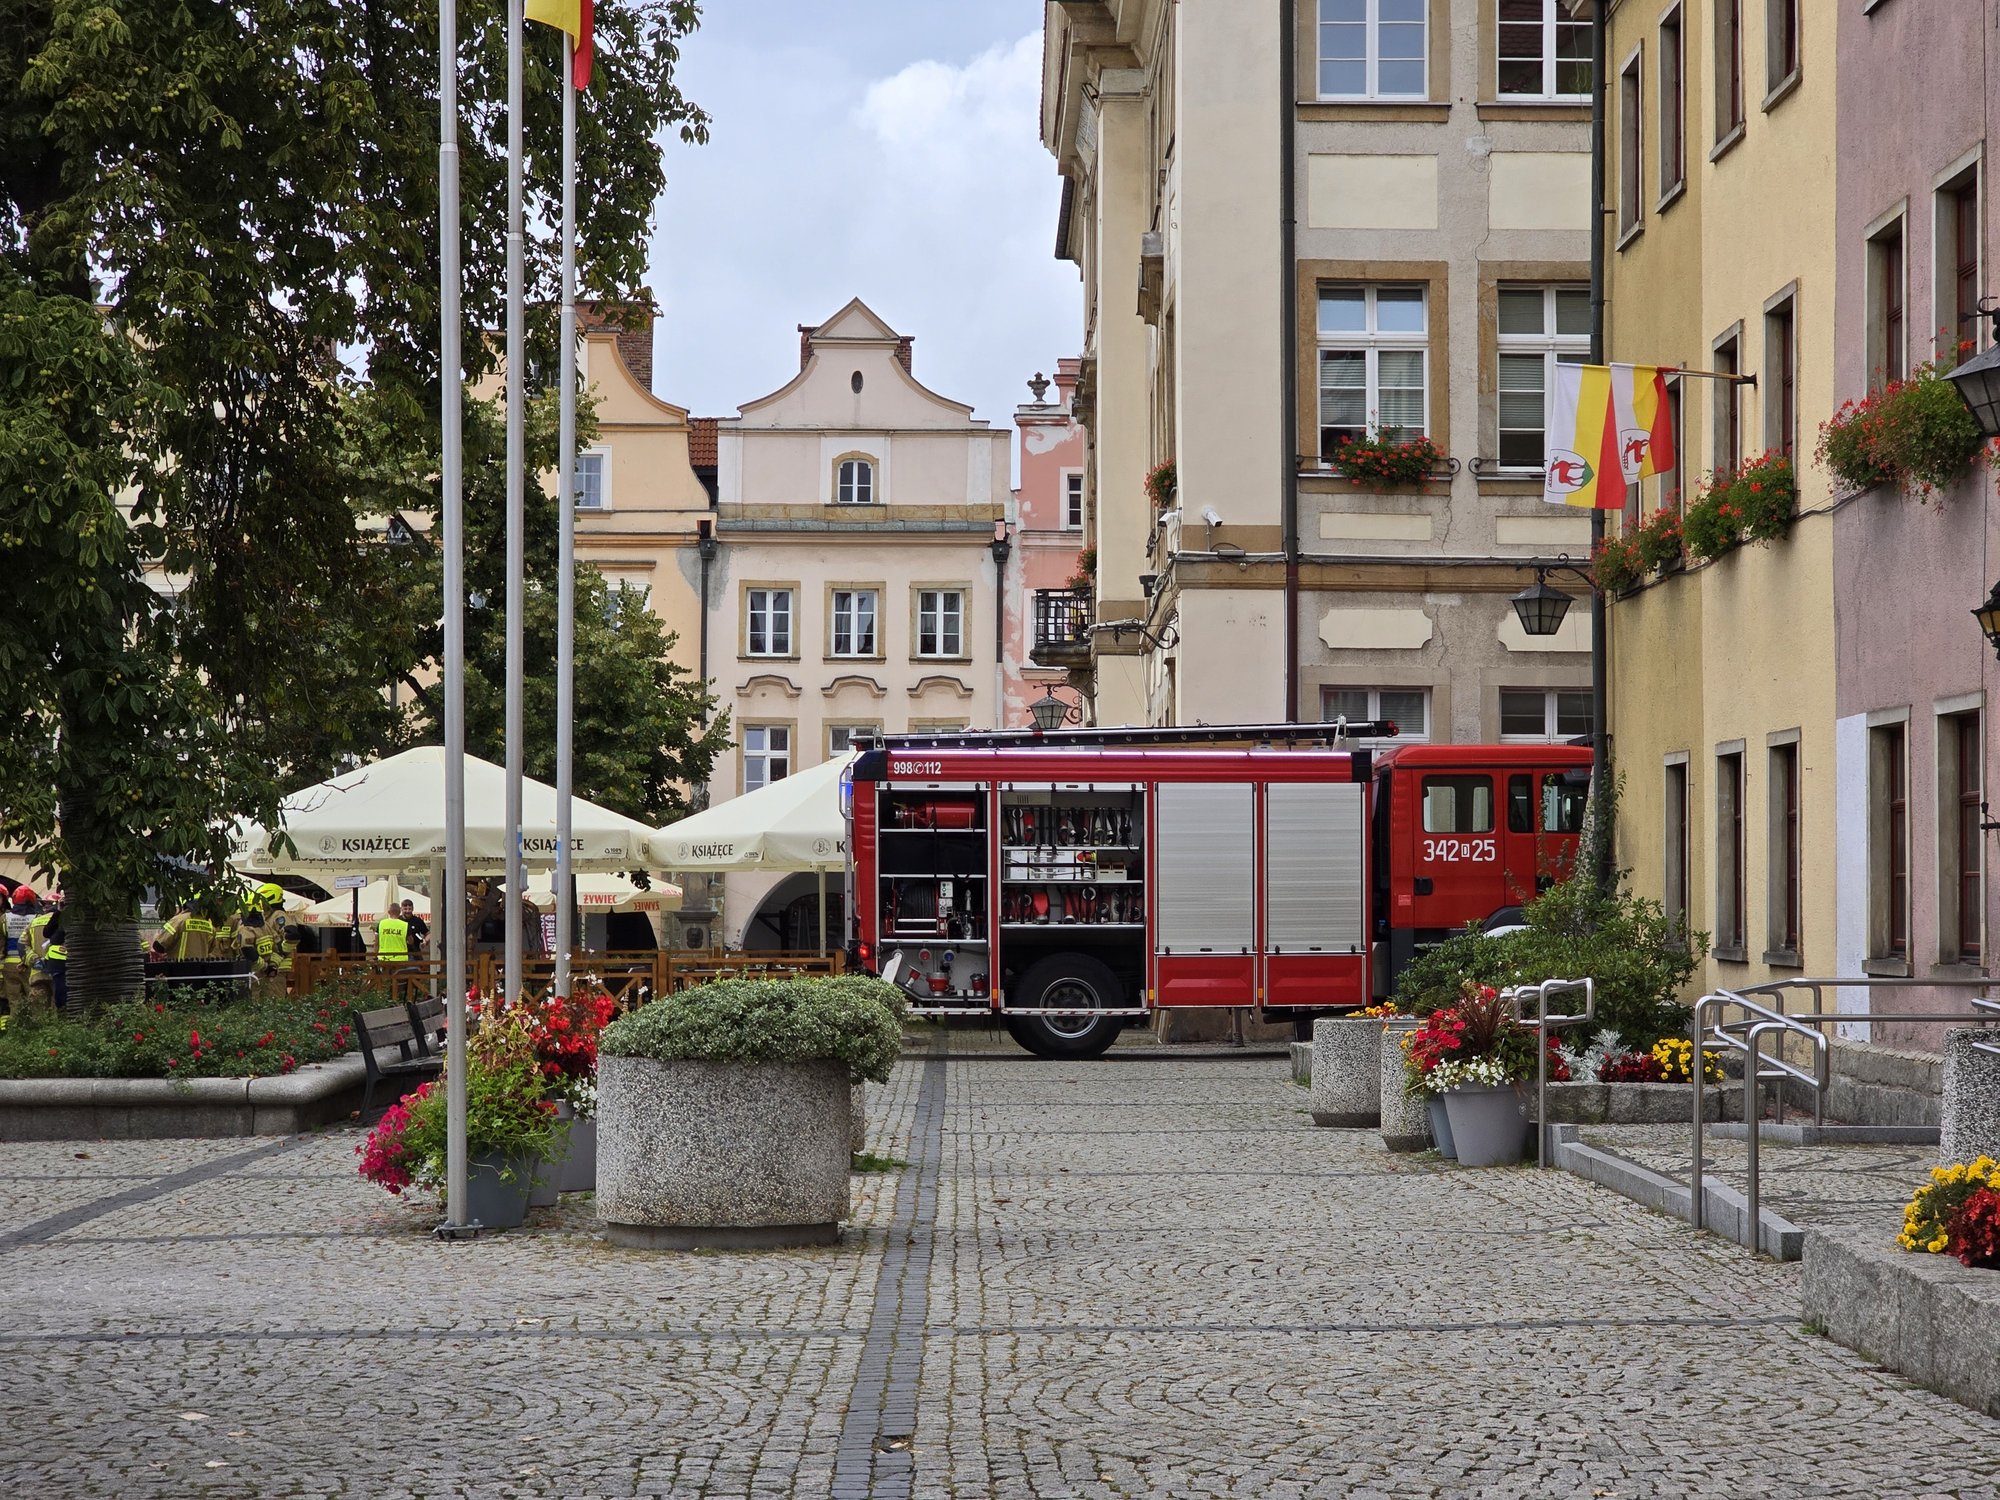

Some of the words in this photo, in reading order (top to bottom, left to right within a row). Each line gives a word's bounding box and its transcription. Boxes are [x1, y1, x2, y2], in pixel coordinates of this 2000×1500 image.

[893, 761, 913, 774] 998
[924, 761, 941, 774] 112
[342, 835, 410, 853] KSIĄŻĘCE
[523, 836, 585, 853] KSIĄŻCE
[691, 841, 734, 859] KSIĄŻĘCE
[1423, 839, 1459, 861] 342
[1472, 839, 1495, 861] 25
[583, 893, 618, 904] ŻYWIEC
